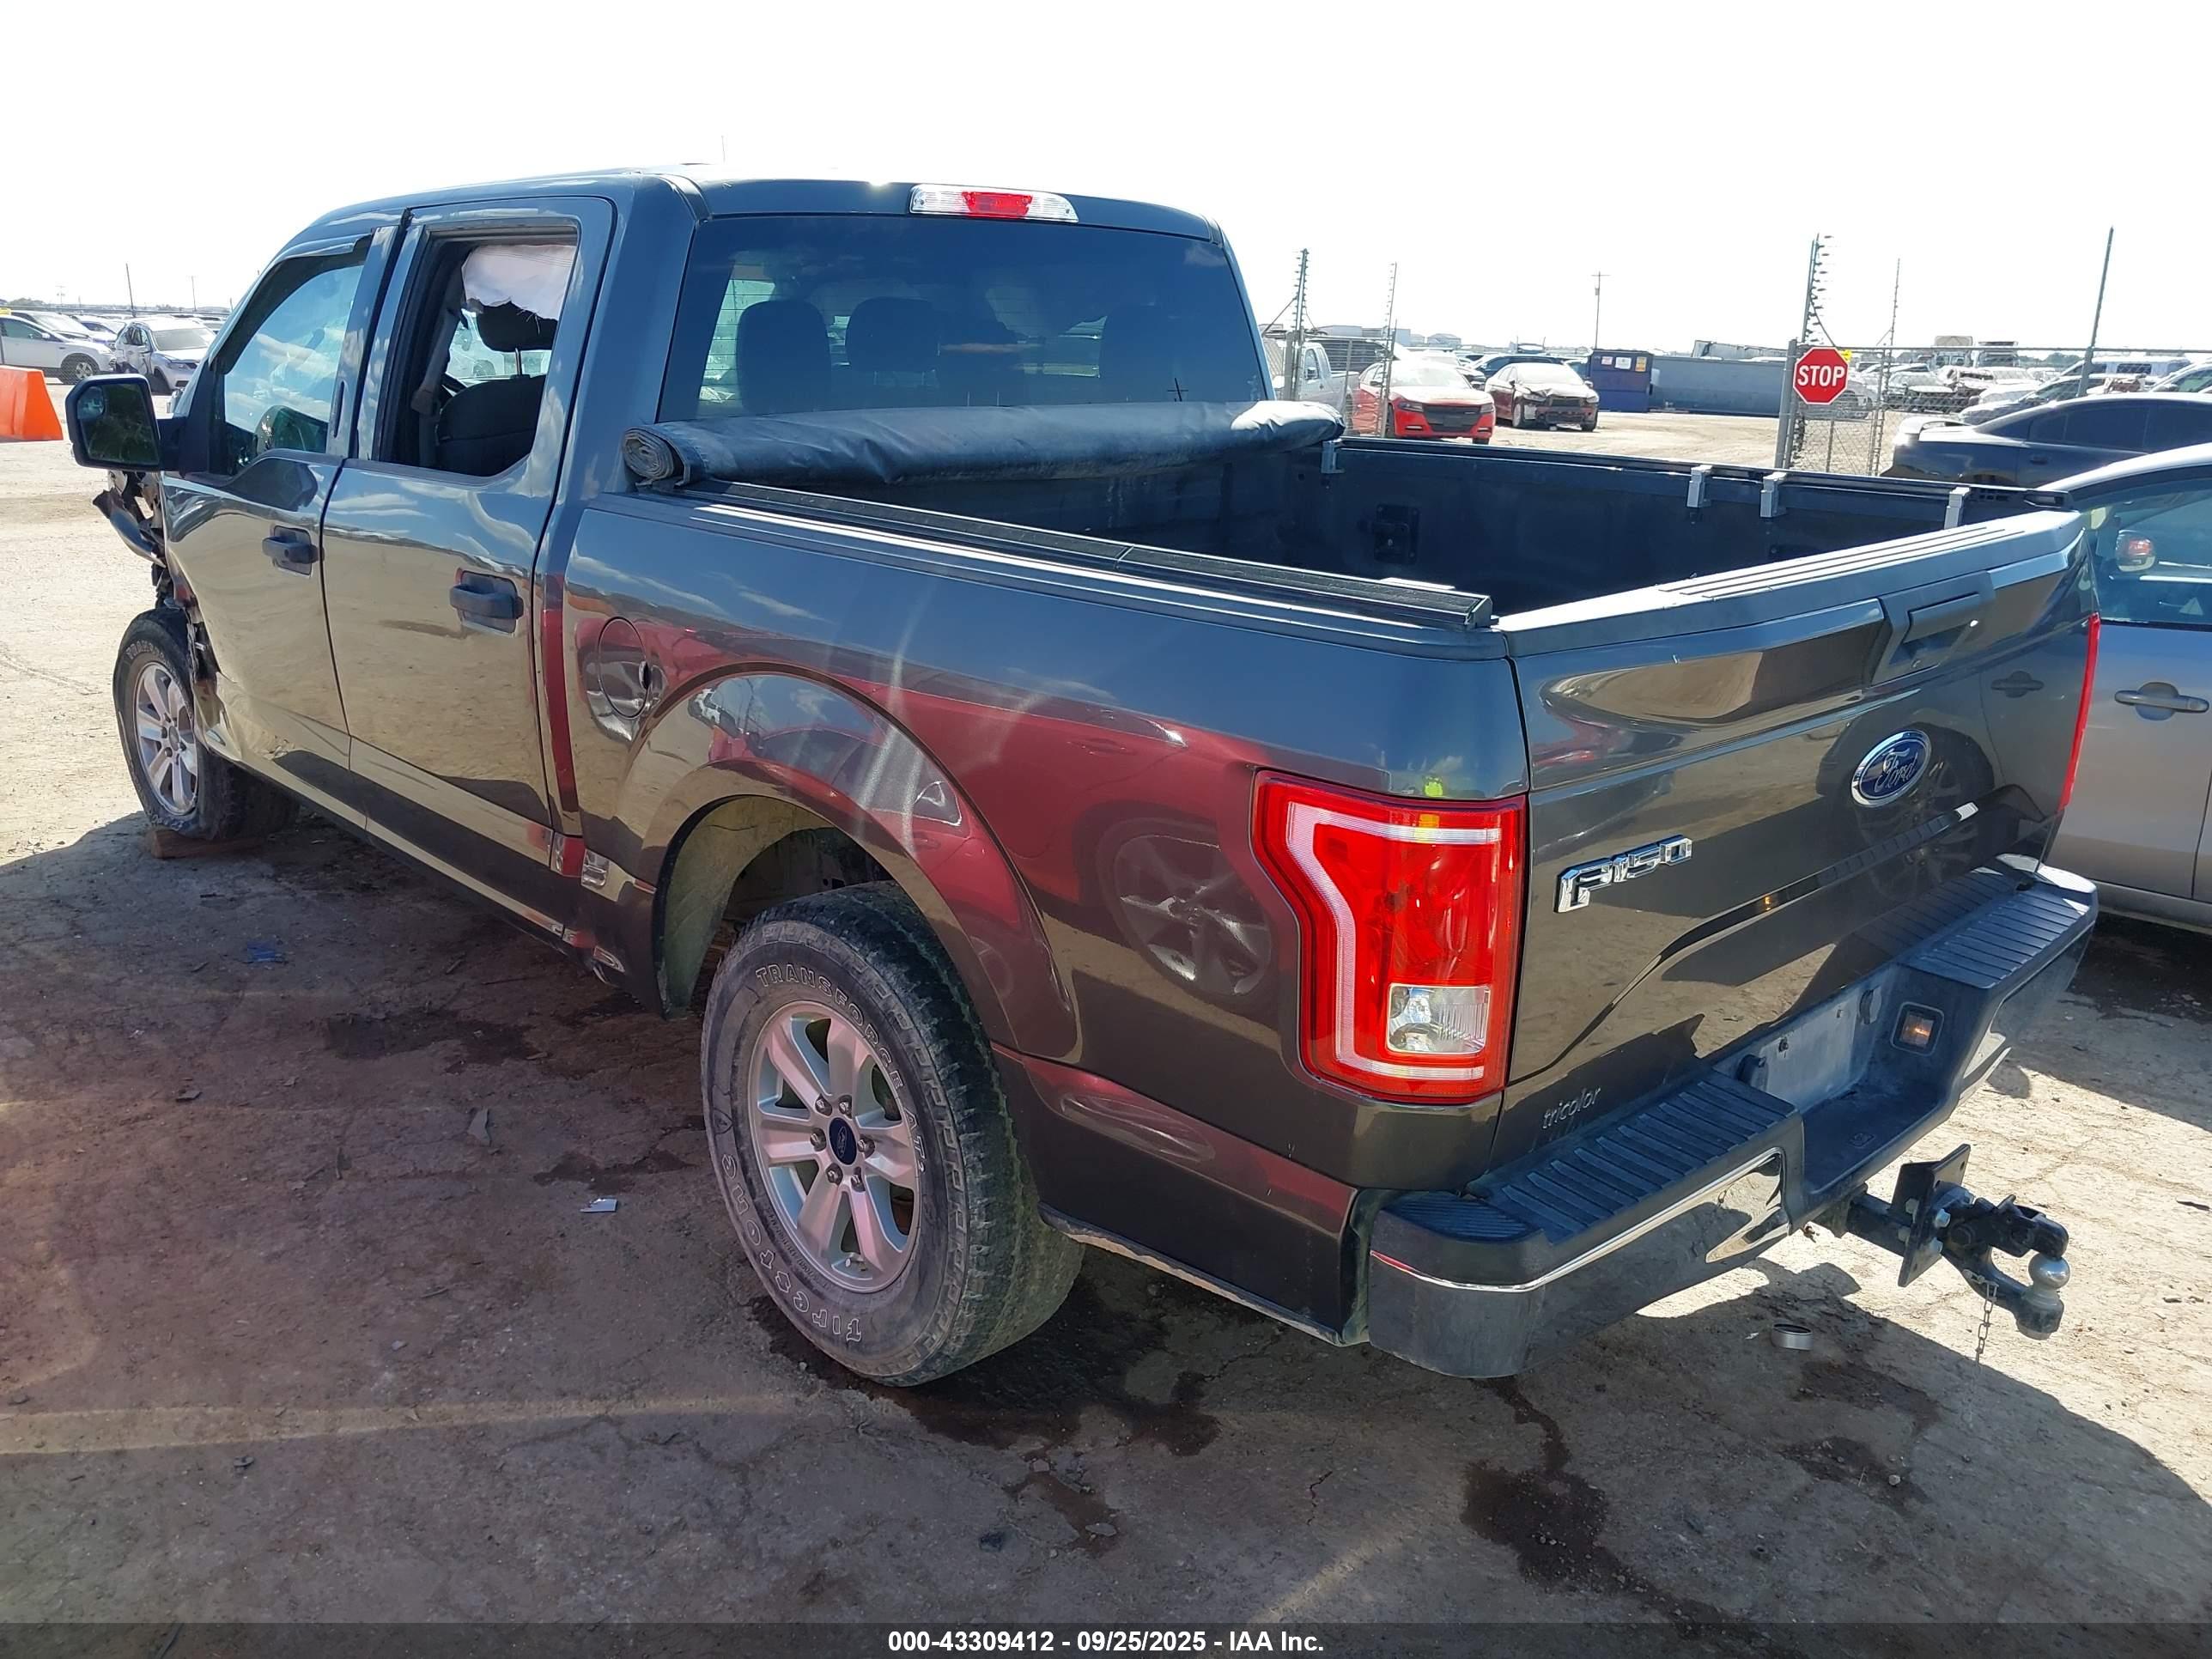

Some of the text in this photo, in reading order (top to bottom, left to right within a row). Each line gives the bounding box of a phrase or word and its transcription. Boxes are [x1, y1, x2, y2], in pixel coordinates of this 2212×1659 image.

[1797, 365, 1845, 387] STOP
[756, 963, 904, 1090] TRANSFORCE
[1542, 1087, 1601, 1129] tricolor
[721, 1153, 862, 1343] Firestone
